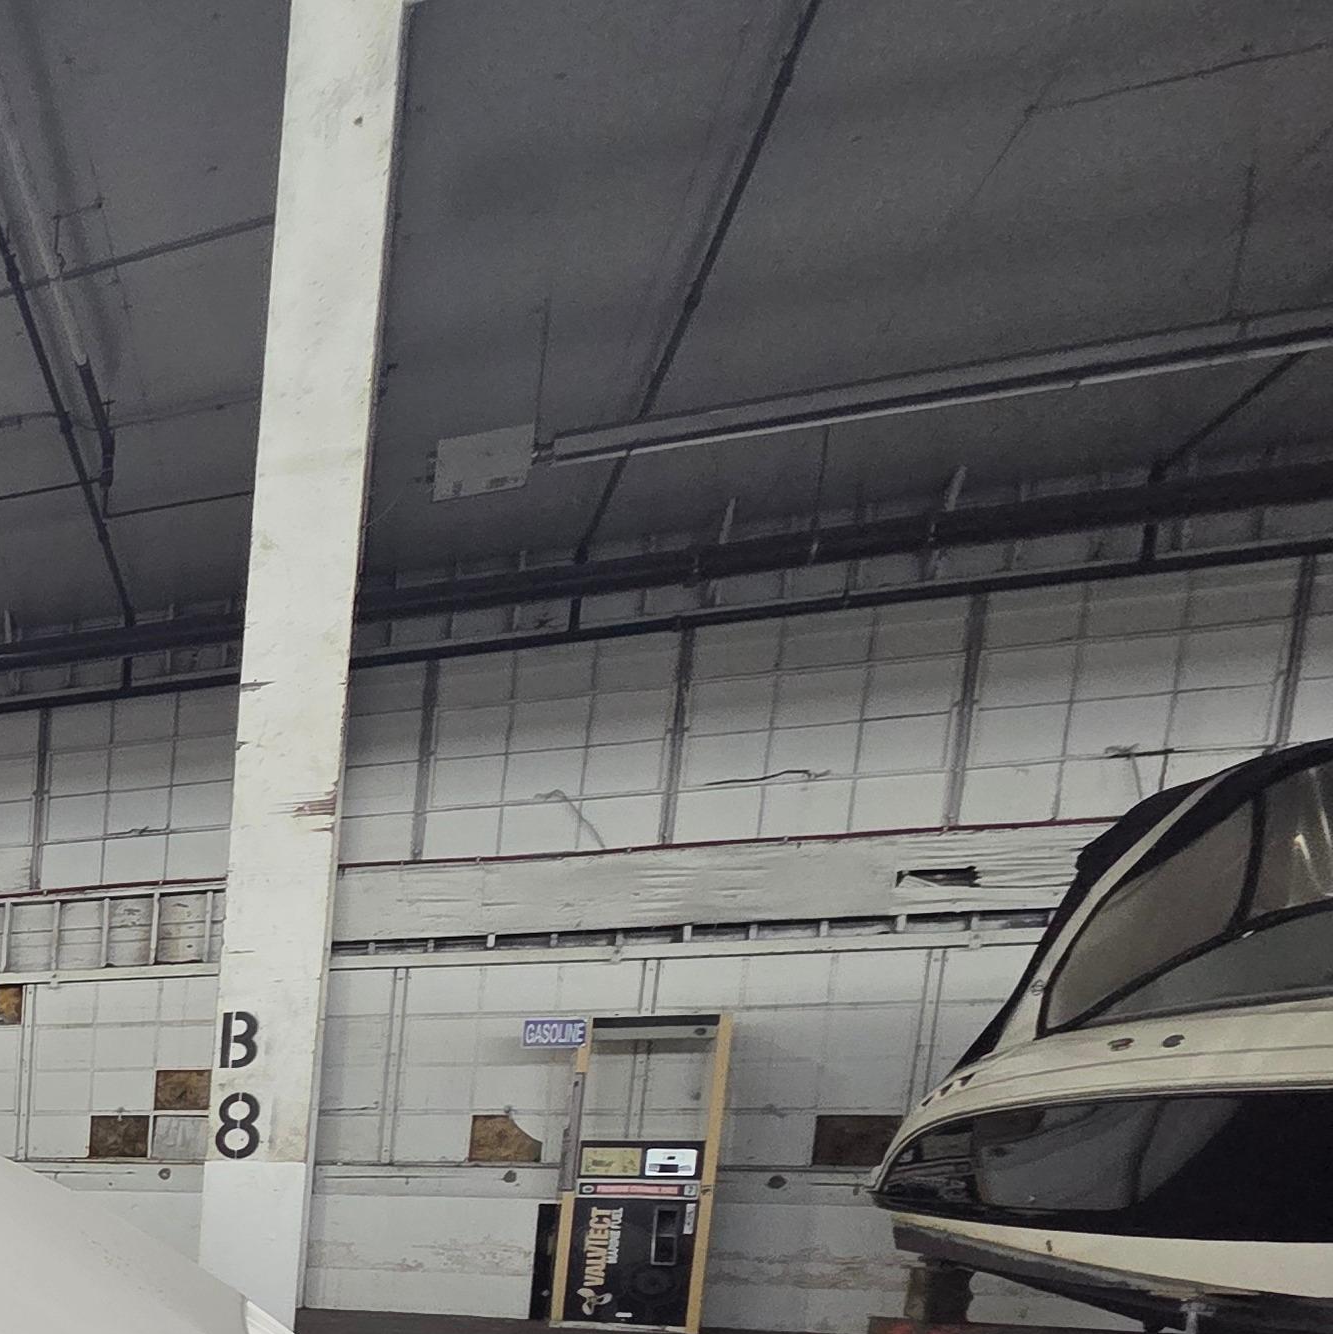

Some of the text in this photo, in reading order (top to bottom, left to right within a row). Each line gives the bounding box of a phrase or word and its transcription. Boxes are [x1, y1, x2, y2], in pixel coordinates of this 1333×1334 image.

[219, 1011, 259, 1069] B
[526, 1022, 585, 1044] GASOLINE
[215, 1091, 261, 1160] 8
